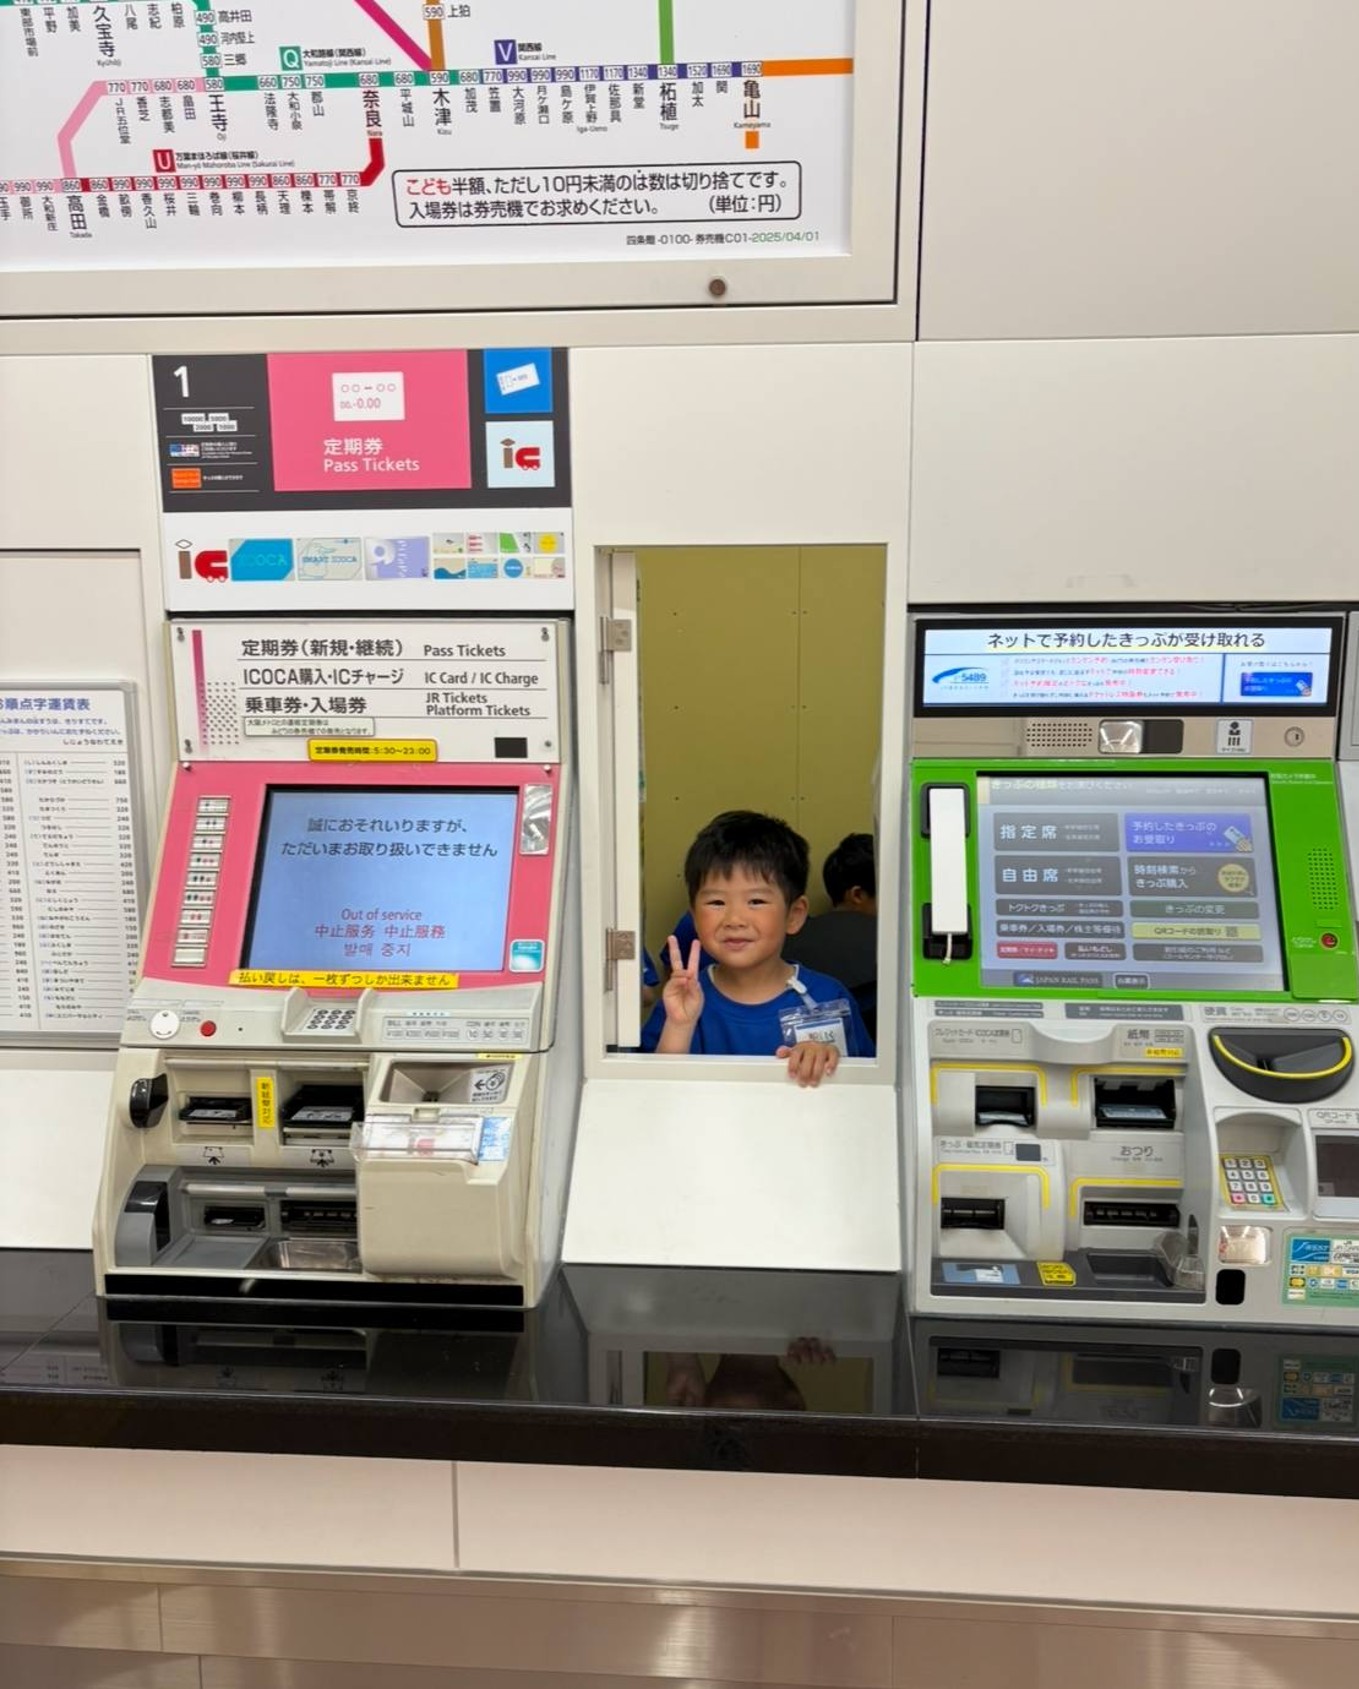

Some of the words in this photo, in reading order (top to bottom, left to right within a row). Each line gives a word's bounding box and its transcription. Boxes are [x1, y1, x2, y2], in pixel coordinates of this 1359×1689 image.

[125, 4, 139, 30] 八尾
[197, 12, 214, 23] 490
[218, 10, 252, 23] 高井田
[425, 7, 443, 17] 590
[43, 7, 57, 33] 平野
[92, 5, 115, 58] 久宝寺
[199, 34, 218, 44] 490
[498, 43, 513, 62] V
[202, 55, 220, 66] 580
[283, 49, 299, 68] Q
[532, 69, 549, 80] 990
[556, 69, 574, 80] 990
[580, 68, 599, 79] 1170
[604, 68, 623, 79] 1170
[629, 67, 648, 78] 1340
[658, 66, 677, 77] 1340
[688, 65, 707, 76] 1520
[712, 64, 731, 76] 1690
[742, 63, 761, 75] 1690
[360, 74, 378, 85] 680
[396, 73, 413, 84] 680
[431, 72, 449, 83] 590
[460, 71, 478, 82] 680
[484, 70, 501, 81] 770
[508, 70, 526, 81] 990
[108, 82, 126, 92] 770
[131, 81, 149, 92] 770
[154, 80, 172, 91] 680
[177, 79, 195, 90] 680
[206, 79, 224, 89] 580
[260, 77, 277, 87] 660
[283, 77, 300, 87] 750
[306, 76, 324, 87] 750
[716, 80, 728, 94] 関
[633, 83, 645, 109] 新堂
[691, 81, 704, 107] 加太
[743, 80, 761, 119] 亀山
[311, 91, 325, 116] 郡山
[465, 88, 478, 113] 加茂
[513, 86, 527, 125] 大河原
[659, 82, 678, 121] 柘植
[264, 92, 279, 131] 法隆寺
[363, 90, 382, 128] 奈良
[432, 88, 452, 126] 木津
[209, 94, 228, 132] 王寺
[659, 122, 680, 131] Tsuge
[733, 121, 771, 130] Kameyama
[158, 153, 171, 170] U
[113, 179, 131, 189] 990
[136, 179, 154, 189] 990
[159, 178, 177, 188] 990
[182, 178, 200, 188] 990
[204, 177, 222, 188] 990
[227, 177, 244, 187] 990
[250, 176, 267, 186] 990
[272, 176, 290, 186] 860
[319, 175, 336, 185] 770
[342, 174, 359, 184] 770
[14, 181, 31, 191] 990
[36, 181, 53, 191] 990
[64, 180, 81, 190] 860
[91, 180, 108, 190] 860
[278, 190, 291, 215] 天理
[67, 195, 87, 230] 高田
[409, 198, 659, 220] 入場券は券売機でお求めください。
[174, 366, 189, 397] 1
[323, 437, 383, 455] 定期券
[324, 458, 358, 472] Pass
[362, 456, 420, 471] Tickets
[988, 632, 1265, 648] ネットで予約したきっぷが受け取れる
[241, 639, 403, 657] 定期券(新規・継続)
[424, 644, 453, 656] Pass
[457, 644, 506, 656] Tickets
[243, 668, 404, 685] ICOCA購入・ICチャージ
[425, 672, 436, 684] IC
[439, 672, 468, 684] Card
[480, 672, 492, 684] IC
[495, 672, 539, 687] Charge
[426, 693, 440, 703] JR
[442, 692, 488, 703] Tickets
[245, 697, 367, 714] 乗車券・入場券
[426, 704, 482, 716] Platform
[486, 704, 531, 716] Tickets
[307, 818, 467, 833] 誠におそれいりますが、
[1133, 821, 1217, 832] 予約したきっぷの
[1000, 825, 1057, 839] 指定席
[281, 841, 498, 857] ただいまお取り扱いできません
[1002, 868, 1058, 882] 自由席
[341, 908, 363, 920] Out
[366, 908, 379, 920] of
[381, 909, 422, 920] service
[1165, 904, 1225, 915] きっぷの変更
[315, 924, 375, 938] 中止服务
[385, 925, 446, 938] 中止服務
[381, 943, 411, 957] 중지
[239, 972, 451, 987] 払い戻しは、一枚ずつしか出来ません
[1120, 1146, 1154, 1156] おつり
